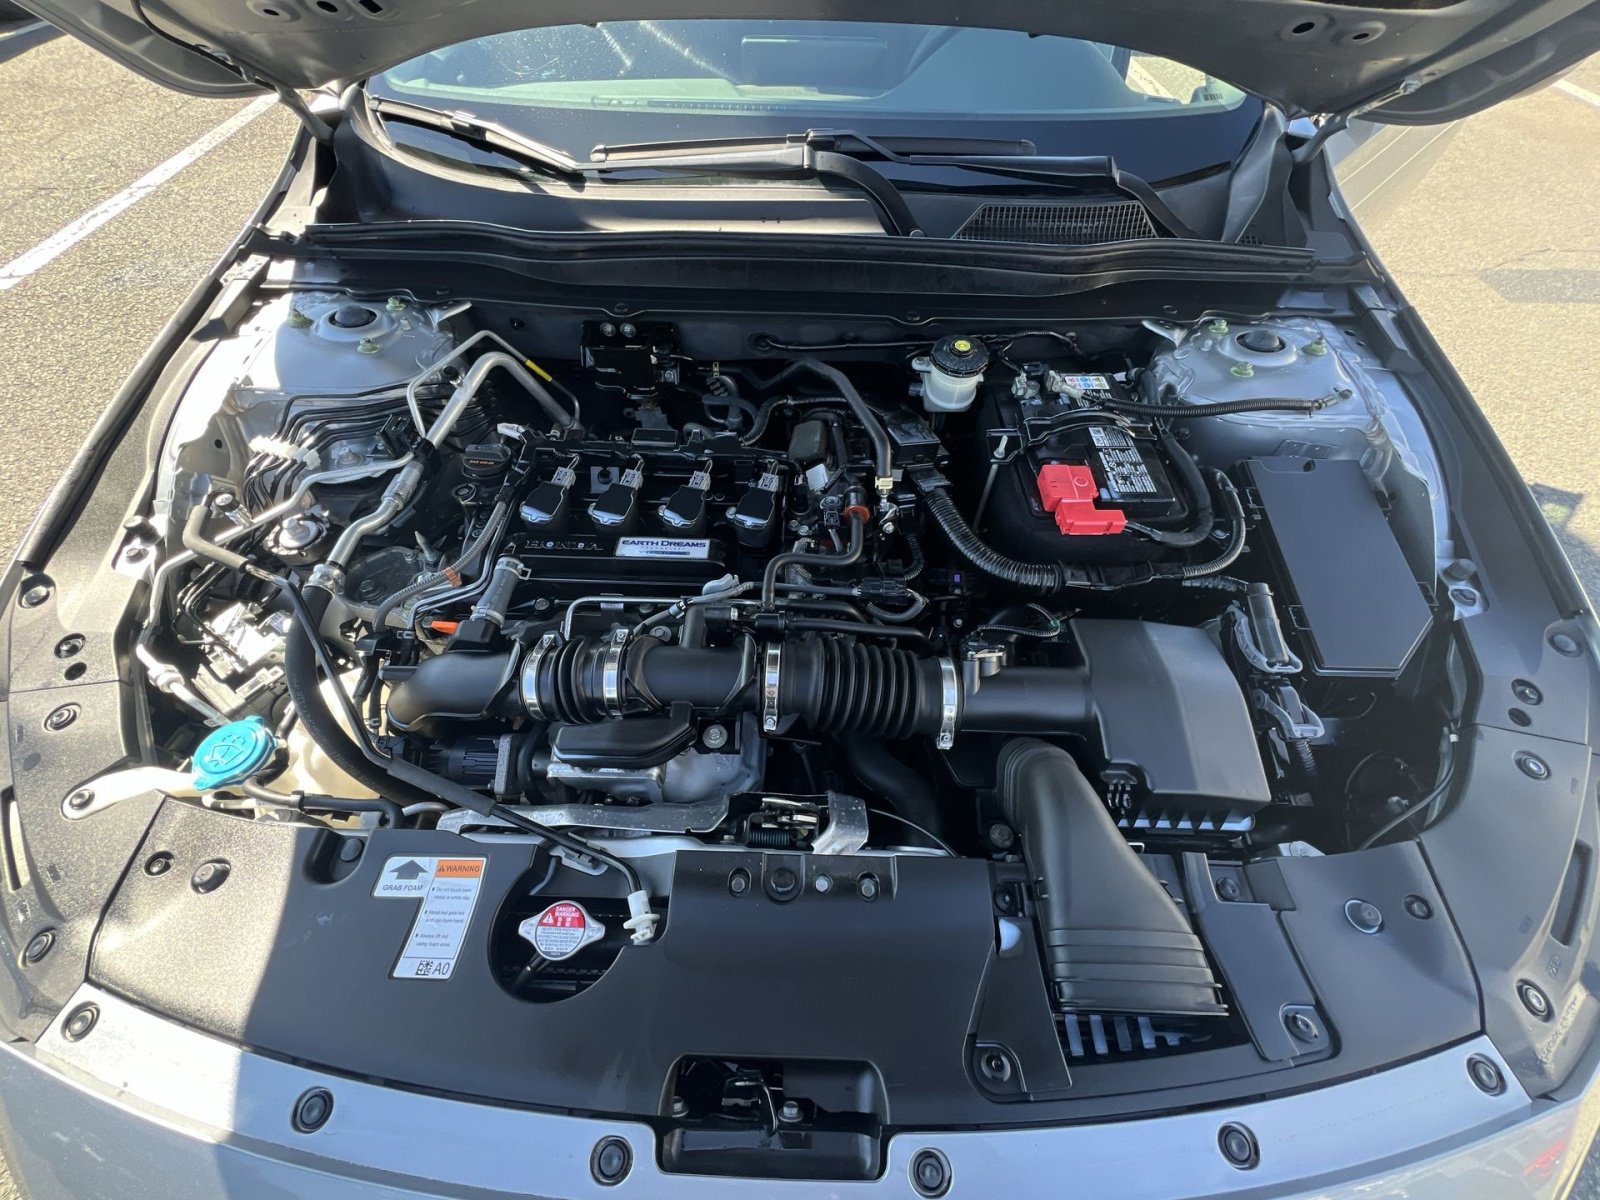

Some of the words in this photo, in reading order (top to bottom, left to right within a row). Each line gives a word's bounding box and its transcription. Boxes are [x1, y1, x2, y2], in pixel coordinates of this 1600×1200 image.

[524, 540, 604, 551] HONDA
[660, 540, 706, 548] DREAMS
[432, 962, 450, 975] A0
